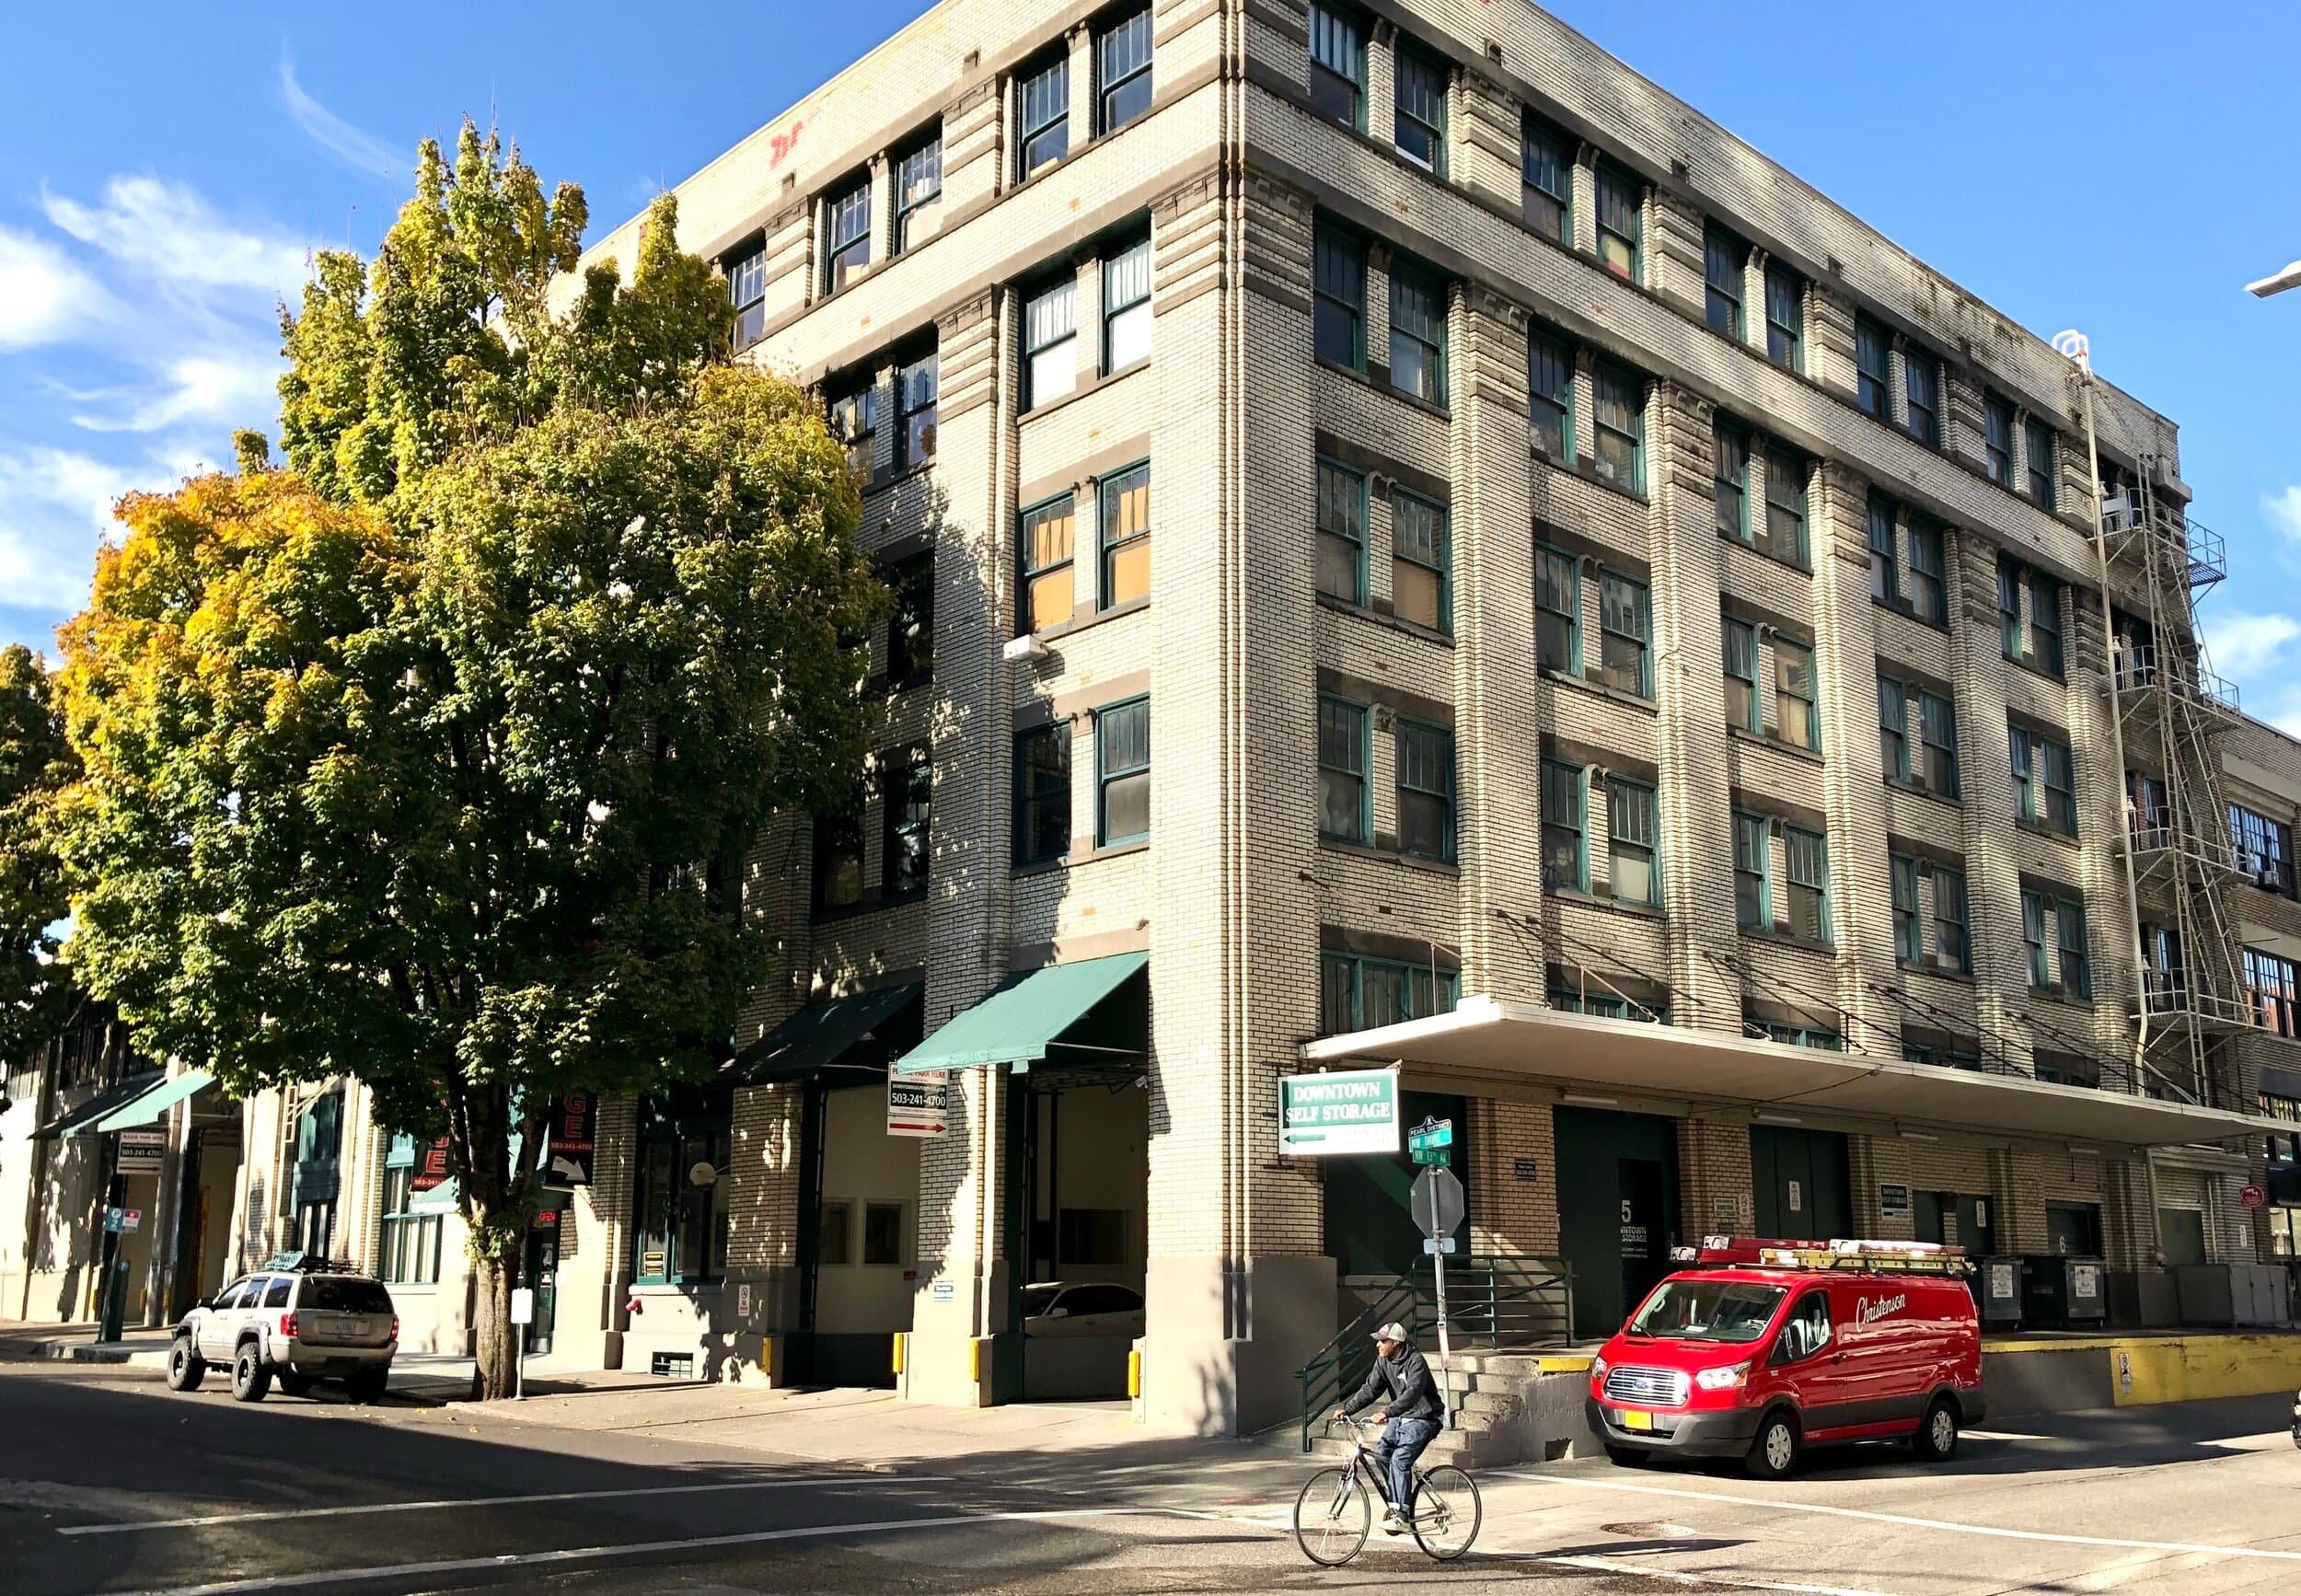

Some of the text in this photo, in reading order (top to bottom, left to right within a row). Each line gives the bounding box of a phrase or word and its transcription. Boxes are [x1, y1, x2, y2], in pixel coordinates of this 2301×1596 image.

[931, 1070, 946, 1079] HERE
[892, 1093, 946, 1106] 503-241-4700
[1293, 1081, 1381, 1102] DOWNTOWN
[1286, 1102, 1391, 1122] SELF STORAGE
[1410, 1121, 1451, 1136] PEARL DISTRICT
[1621, 1199, 1632, 1223] 5
[2059, 1236, 2066, 1254] 6
[1856, 1293, 1906, 1333] Christenson
